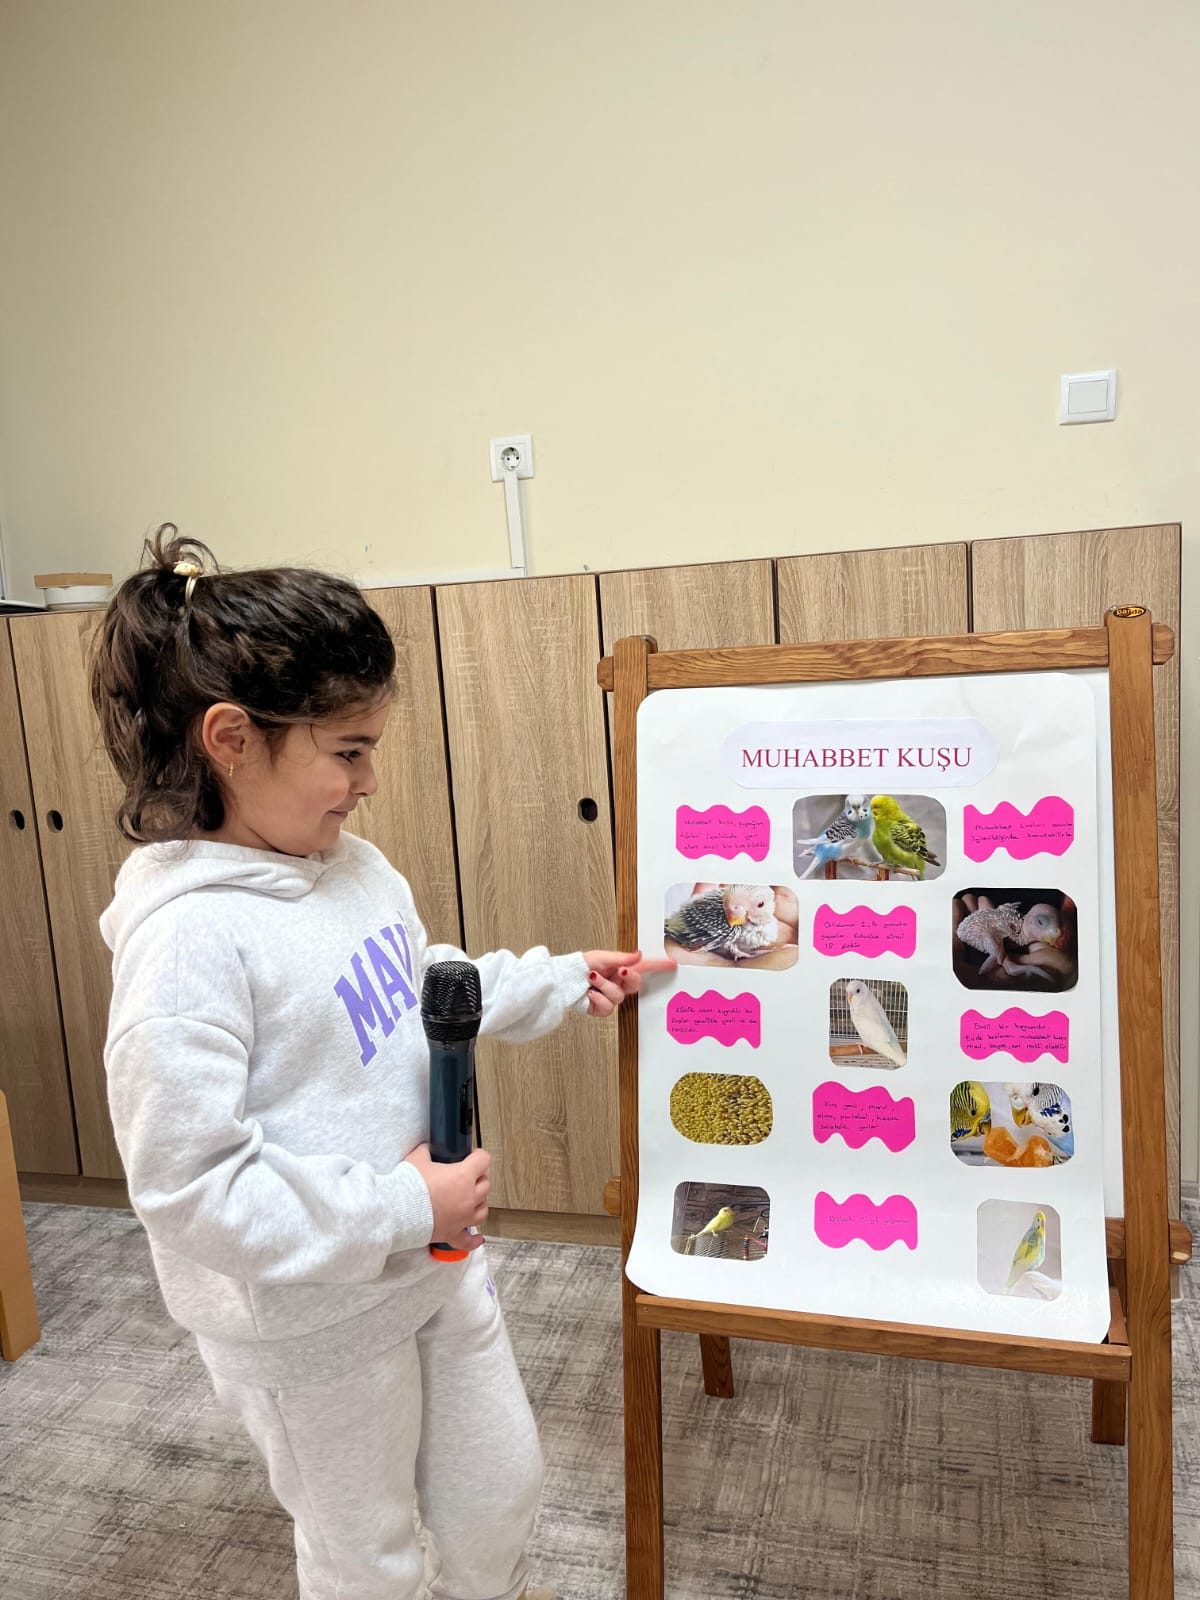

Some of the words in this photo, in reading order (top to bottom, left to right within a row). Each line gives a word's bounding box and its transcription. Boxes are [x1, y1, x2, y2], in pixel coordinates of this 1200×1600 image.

[741, 748, 890, 768] MUHABBET
[896, 747, 973, 772] KUŞU
[825, 942, 834, 950] 18
[333, 911, 418, 1067] MAV
